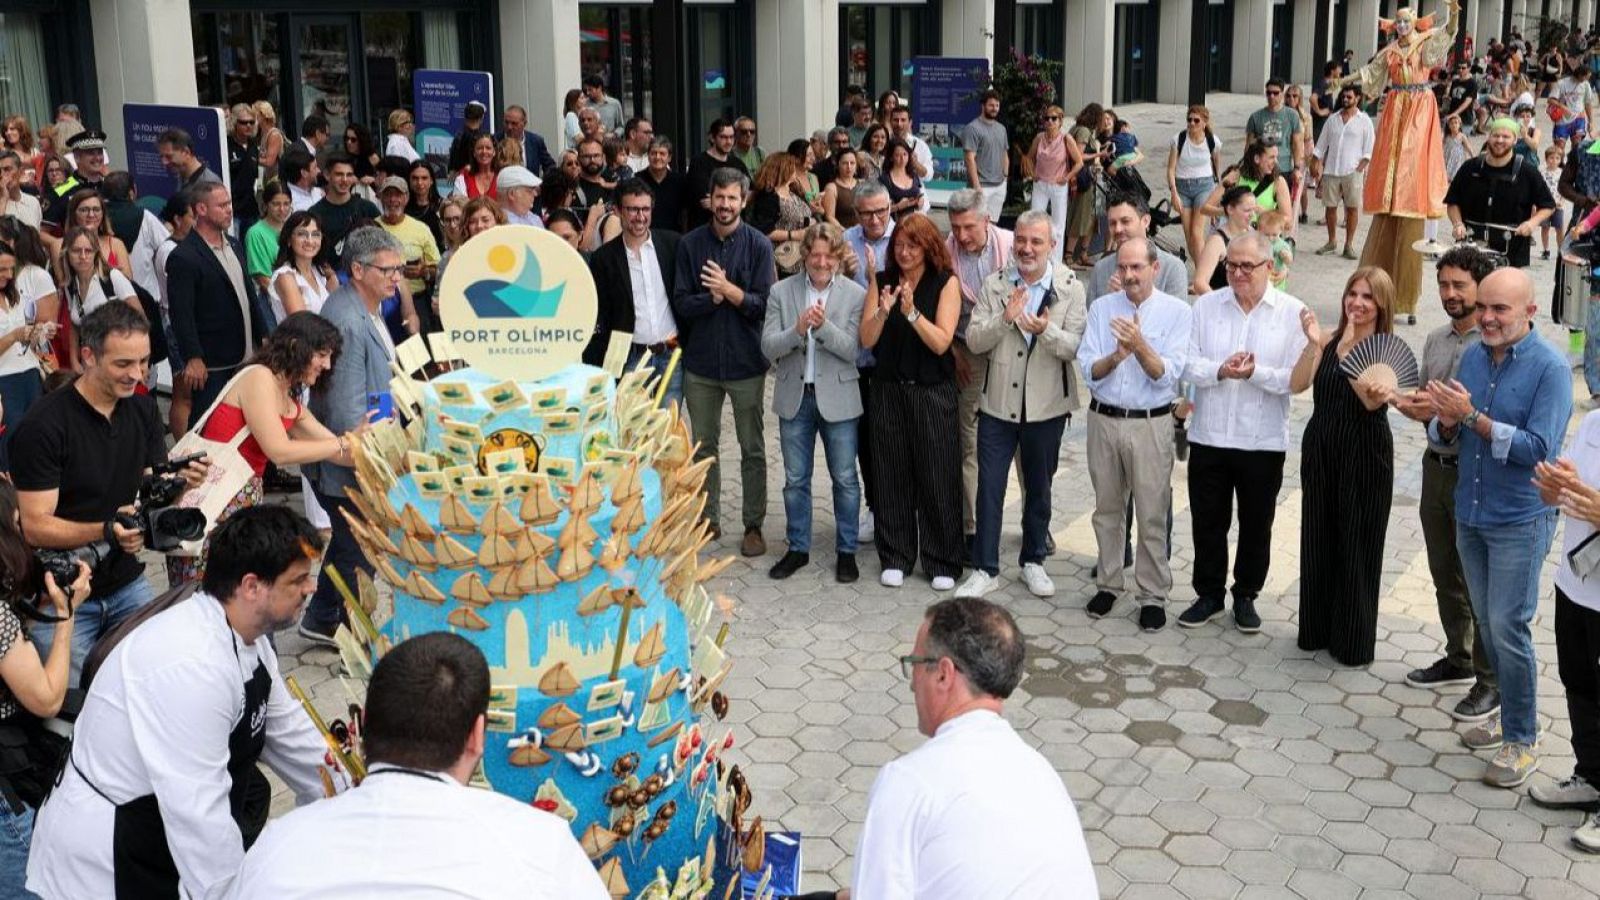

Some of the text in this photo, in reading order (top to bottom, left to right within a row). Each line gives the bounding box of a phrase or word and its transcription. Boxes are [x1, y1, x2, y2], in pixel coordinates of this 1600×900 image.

[451, 326, 584, 342] PORT OLÍMPIC
[488, 347, 547, 355] BARCELONA
